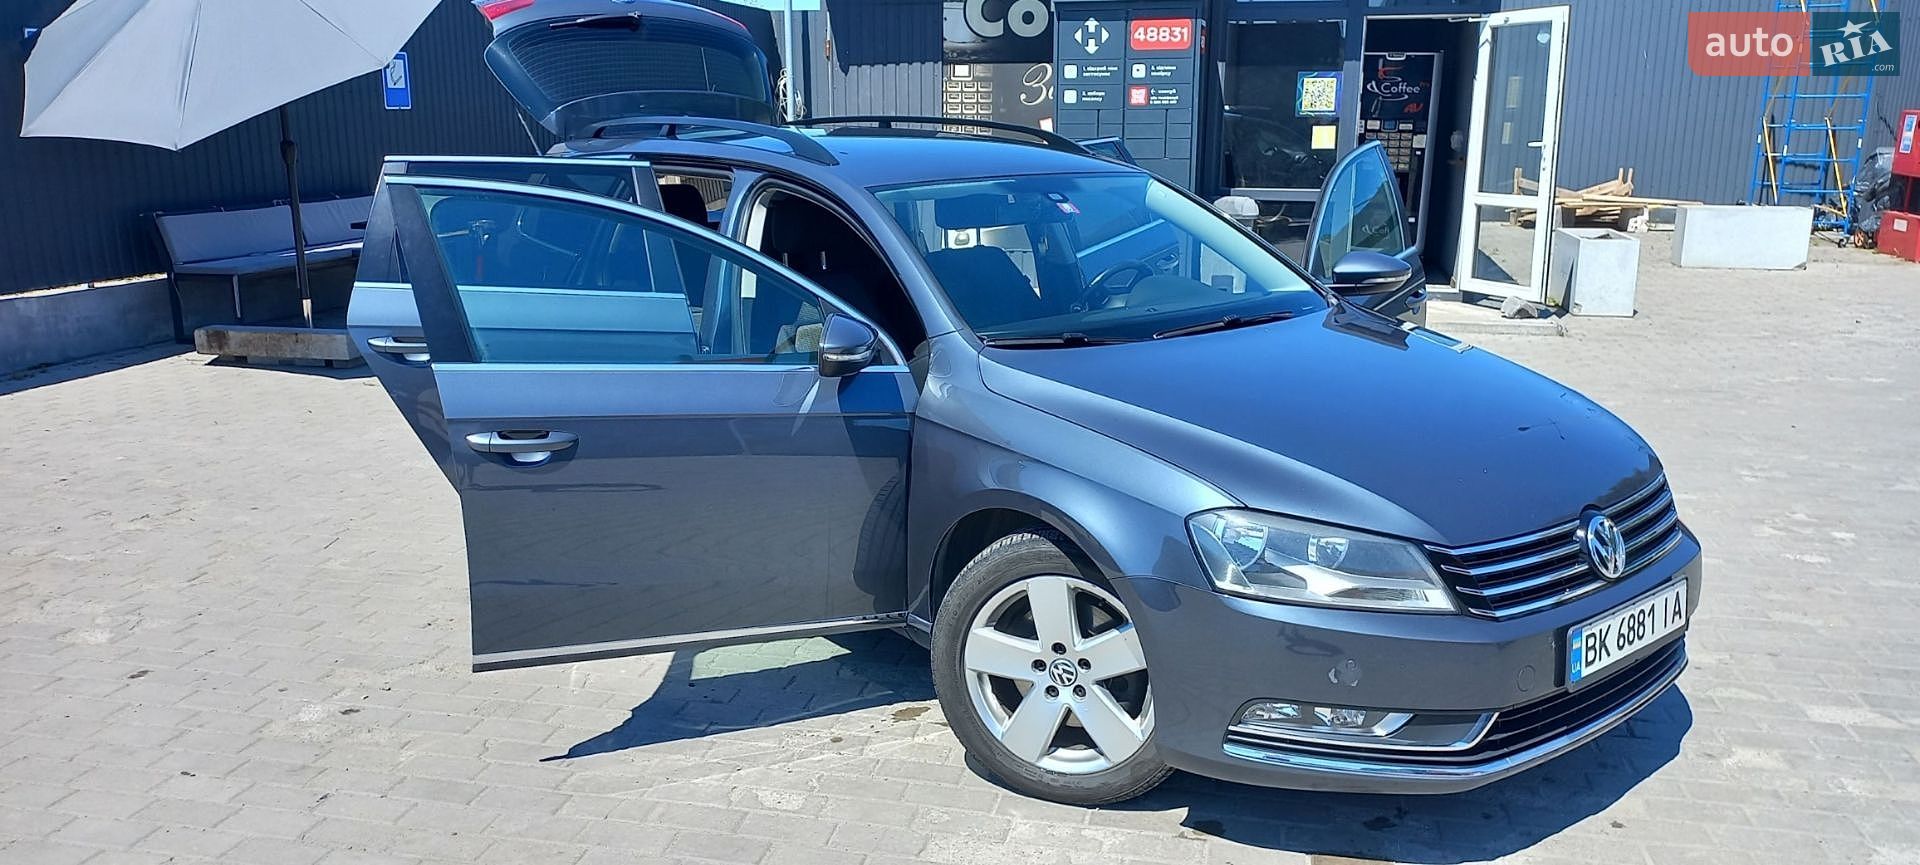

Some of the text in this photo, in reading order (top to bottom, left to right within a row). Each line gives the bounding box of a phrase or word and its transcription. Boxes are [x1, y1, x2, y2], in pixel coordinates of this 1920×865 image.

[1133, 26, 1189, 42] 48831
[1381, 82, 1421, 93] Coffee
[1584, 590, 1682, 668] BK 6881 IA
[1571, 661, 1581, 674] UA
